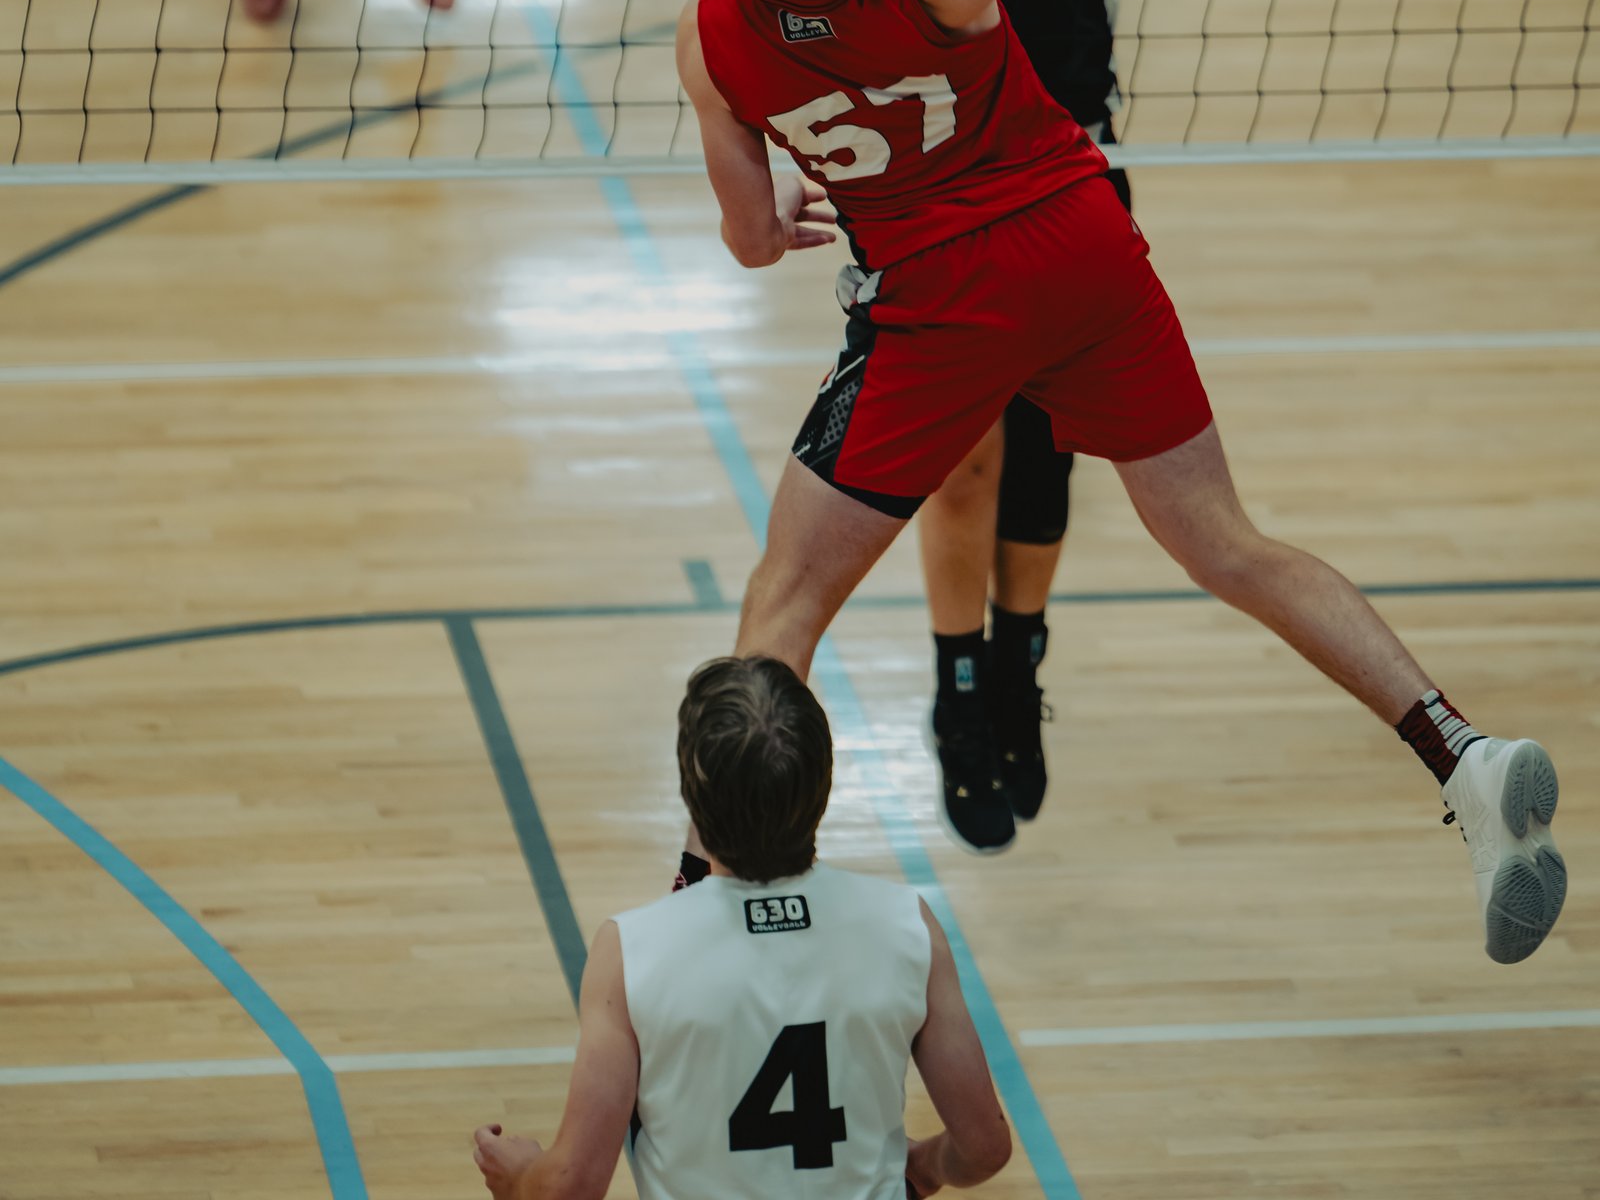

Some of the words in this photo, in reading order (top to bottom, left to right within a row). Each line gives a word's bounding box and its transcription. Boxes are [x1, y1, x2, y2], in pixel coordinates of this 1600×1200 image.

[767, 74, 957, 182] 57
[750, 897, 804, 924] 630
[752, 921, 806, 932] VOLLEYBALL
[729, 1021, 847, 1169] 4
